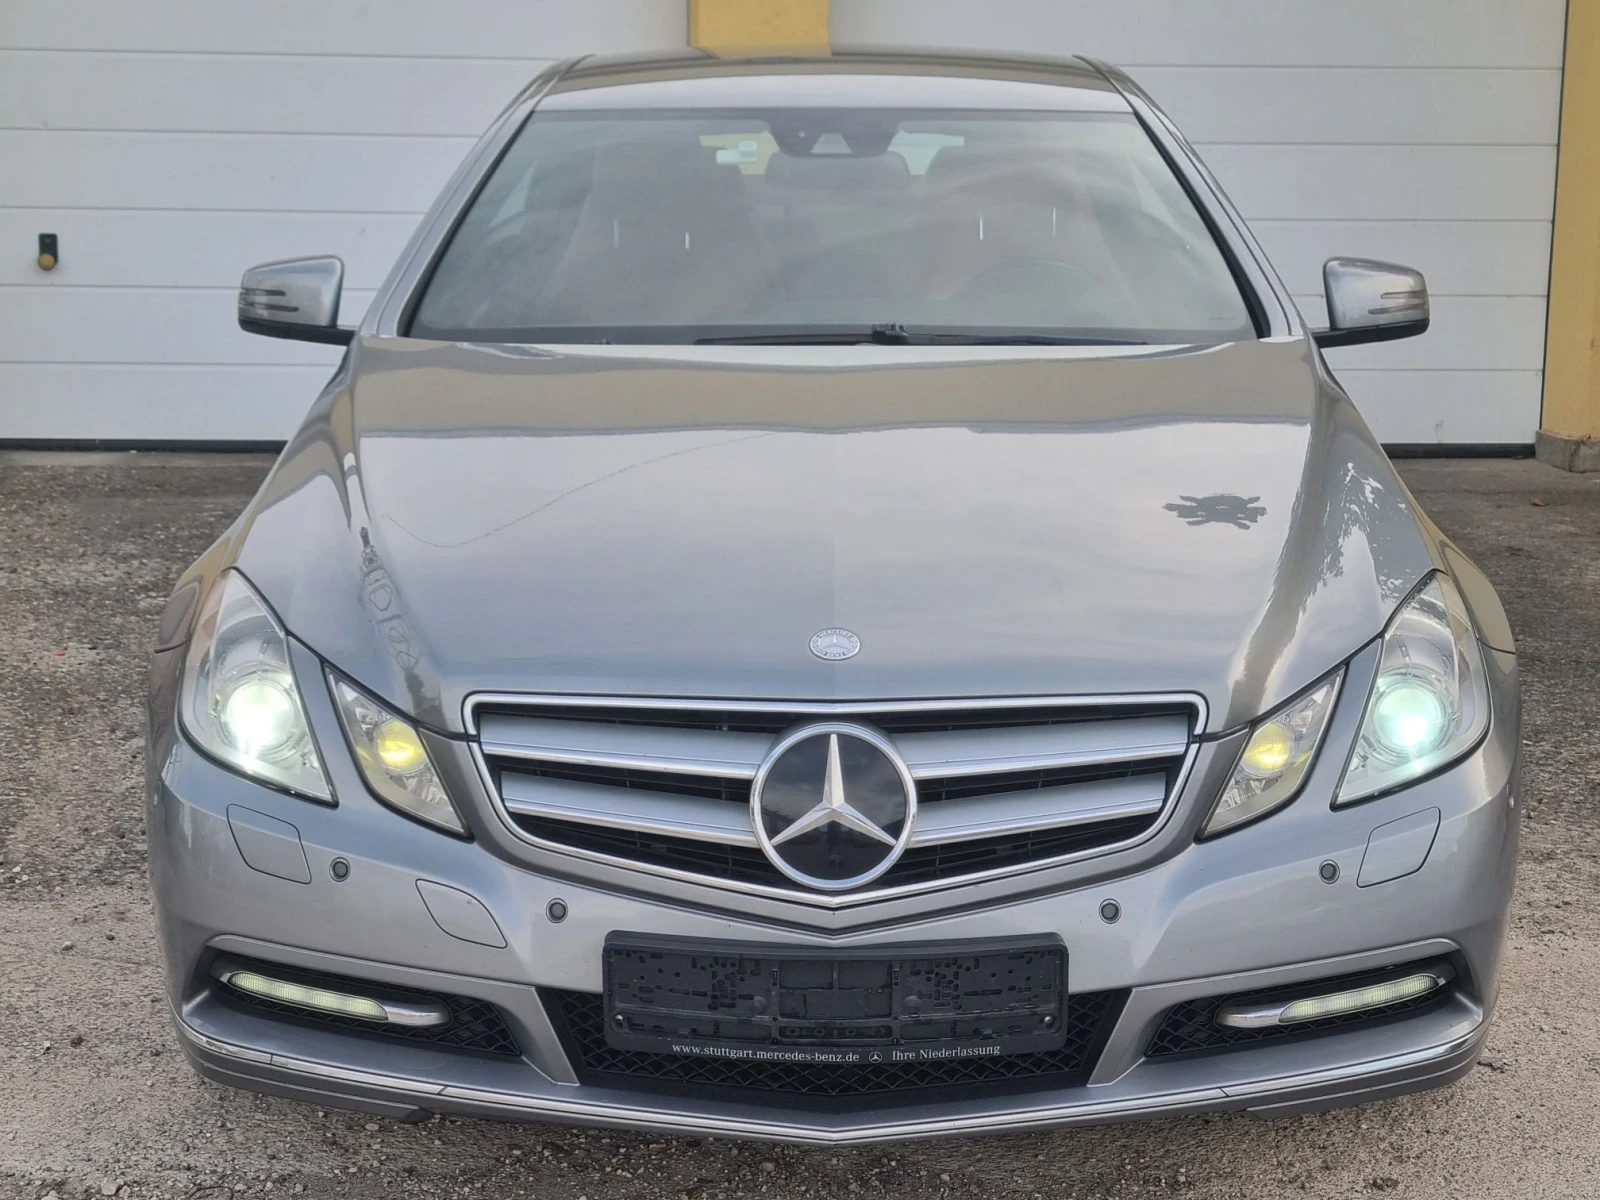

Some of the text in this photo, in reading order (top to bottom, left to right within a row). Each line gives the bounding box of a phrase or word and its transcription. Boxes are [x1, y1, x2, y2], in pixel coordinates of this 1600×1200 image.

[672, 1043, 1001, 1062] www.stuttgart.mercedes-benz.de Ihre Niederlassung
